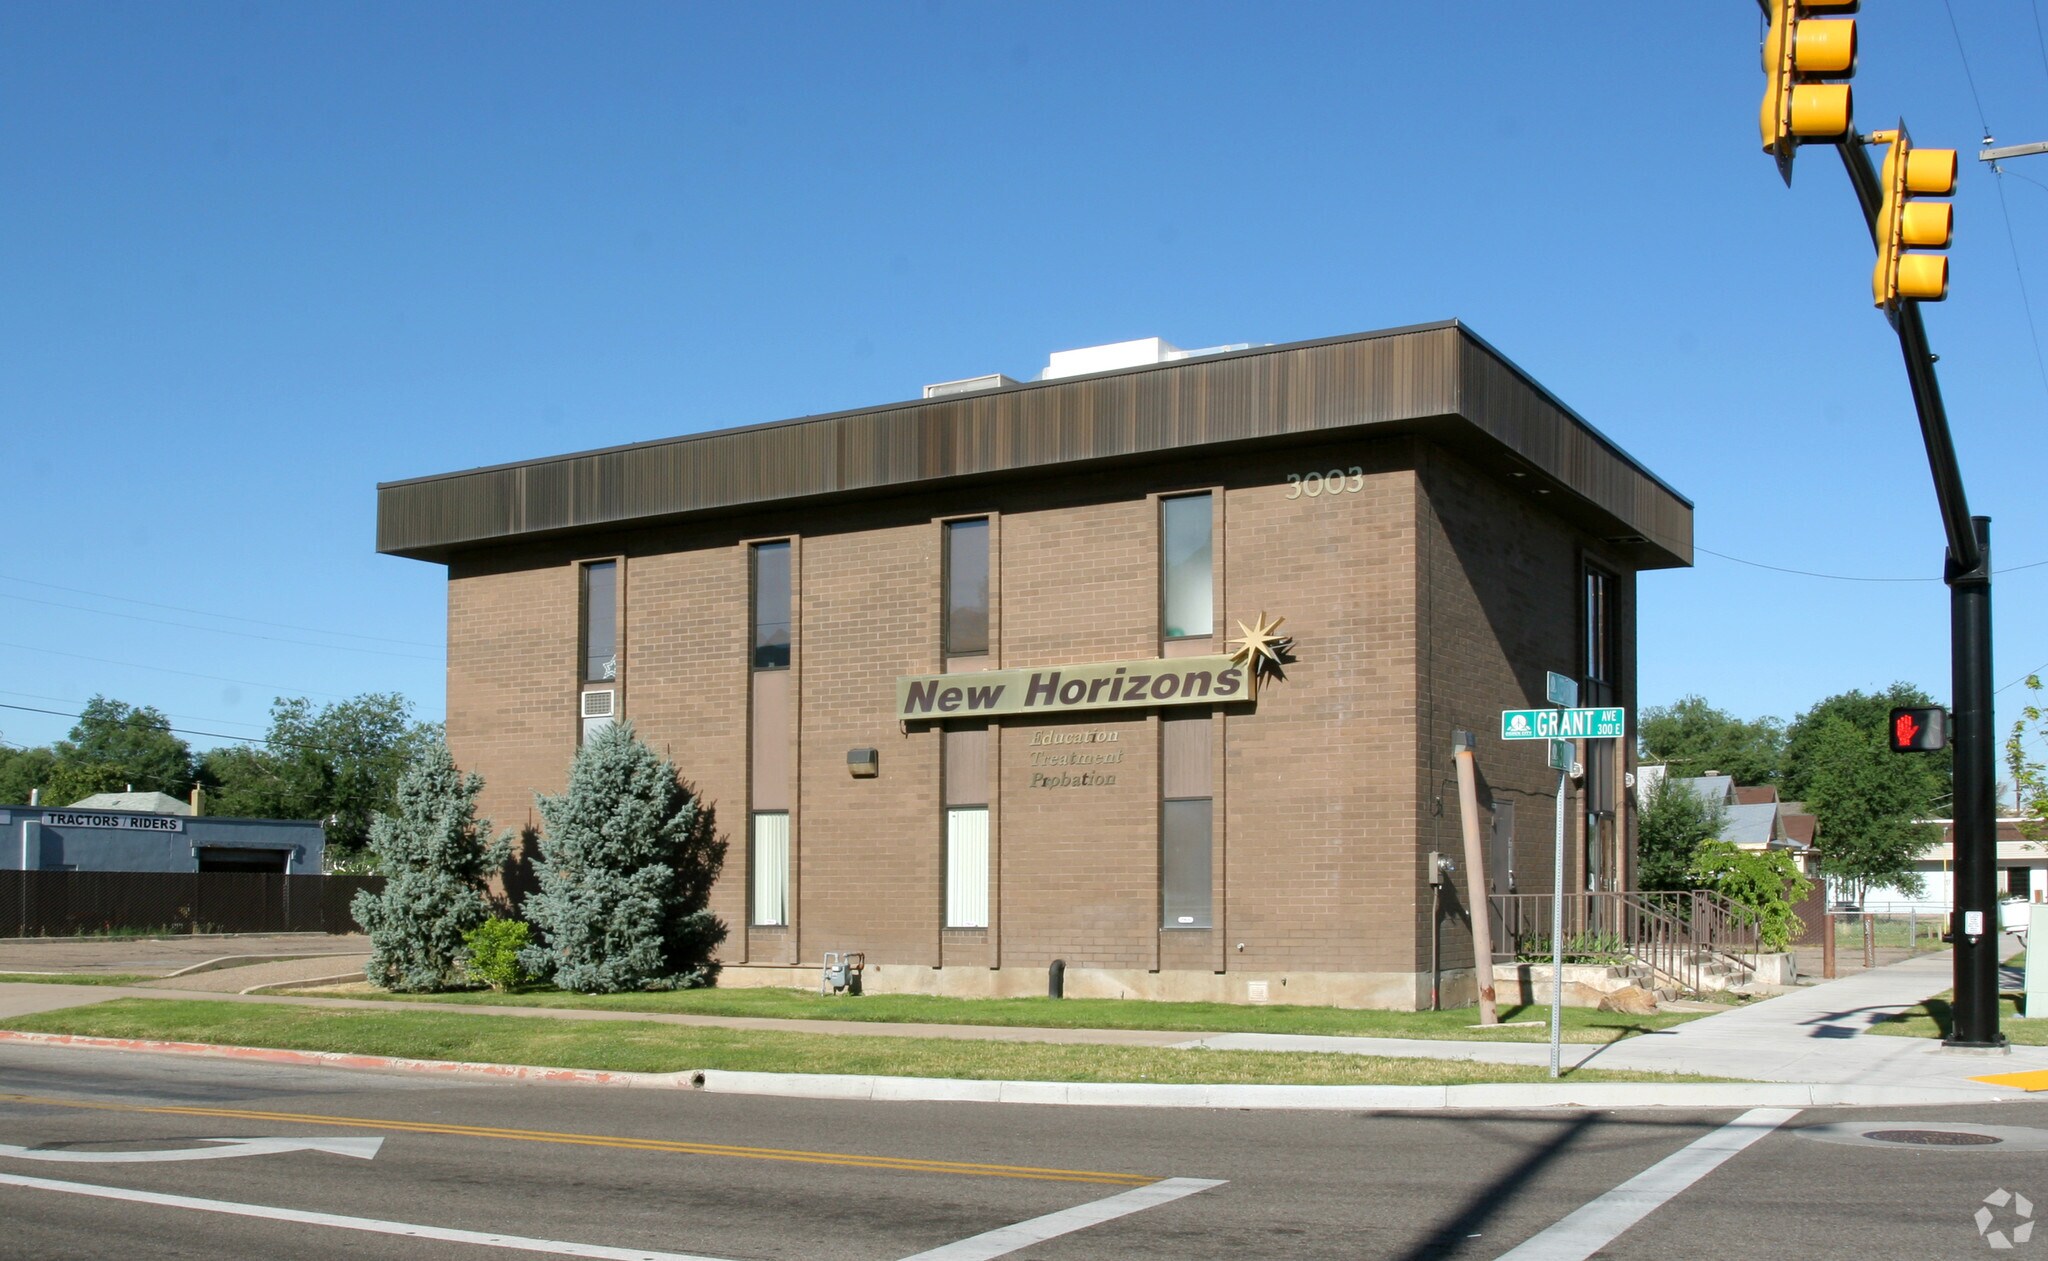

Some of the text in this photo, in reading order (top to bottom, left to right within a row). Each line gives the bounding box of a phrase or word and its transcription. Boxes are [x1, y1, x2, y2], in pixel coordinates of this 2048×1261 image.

[1285, 466, 1364, 499] 3003
[903, 667, 1242, 714] New Horizons
[1537, 711, 1594, 736] GRANT
[1602, 710, 1617, 722] AVE
[1597, 723, 1620, 735] 300 E
[1029, 730, 1119, 746] Education
[1030, 749, 1124, 767] Treatment
[48, 813, 119, 827] TRACTORS
[130, 817, 177, 830] RIDERS
